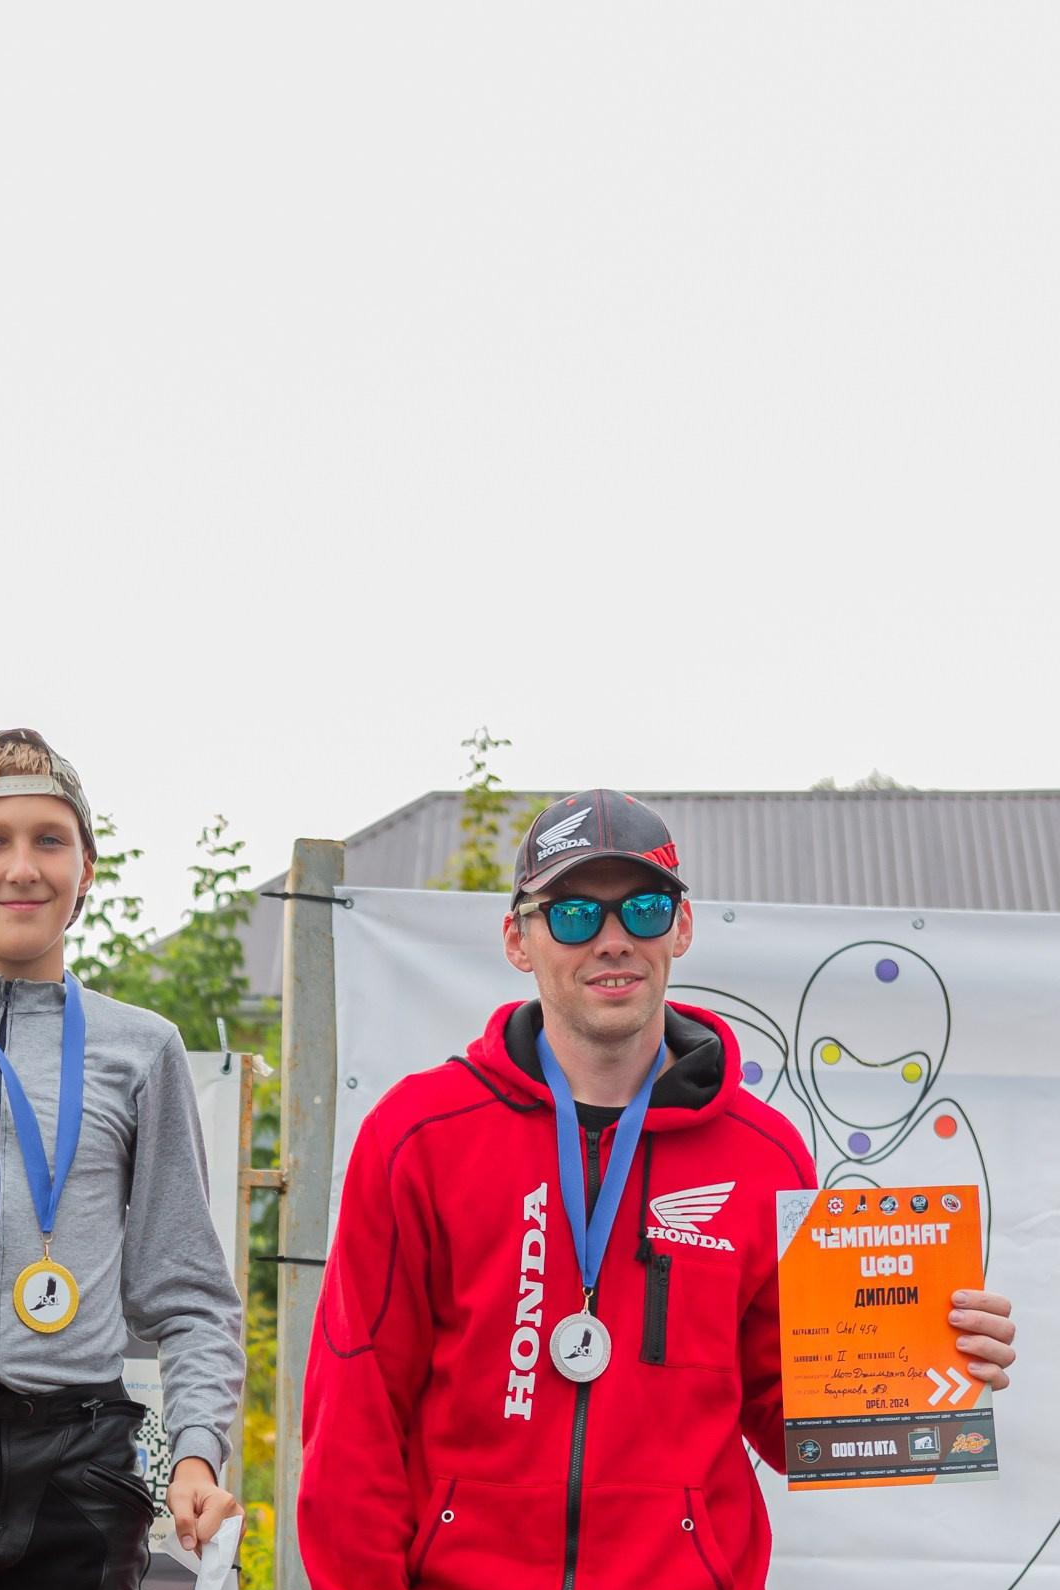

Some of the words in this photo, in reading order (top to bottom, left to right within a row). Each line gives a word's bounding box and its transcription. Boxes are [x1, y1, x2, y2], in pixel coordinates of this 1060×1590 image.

[538, 838, 591, 861] HONDA
[646, 1226, 735, 1251] HONDA
[812, 1223, 950, 1249] ЧЕМПИОНАТ
[861, 1255, 913, 1277] ЦФО
[504, 1182, 547, 1420] HONDA
[855, 1287, 918, 1308] ДИПЛОМ
[890, 1398, 909, 1407] 2024
[831, 1442, 855, 1458] ООО
[857, 1441, 874, 1457] ТД
[875, 1440, 897, 1456] ИТА
